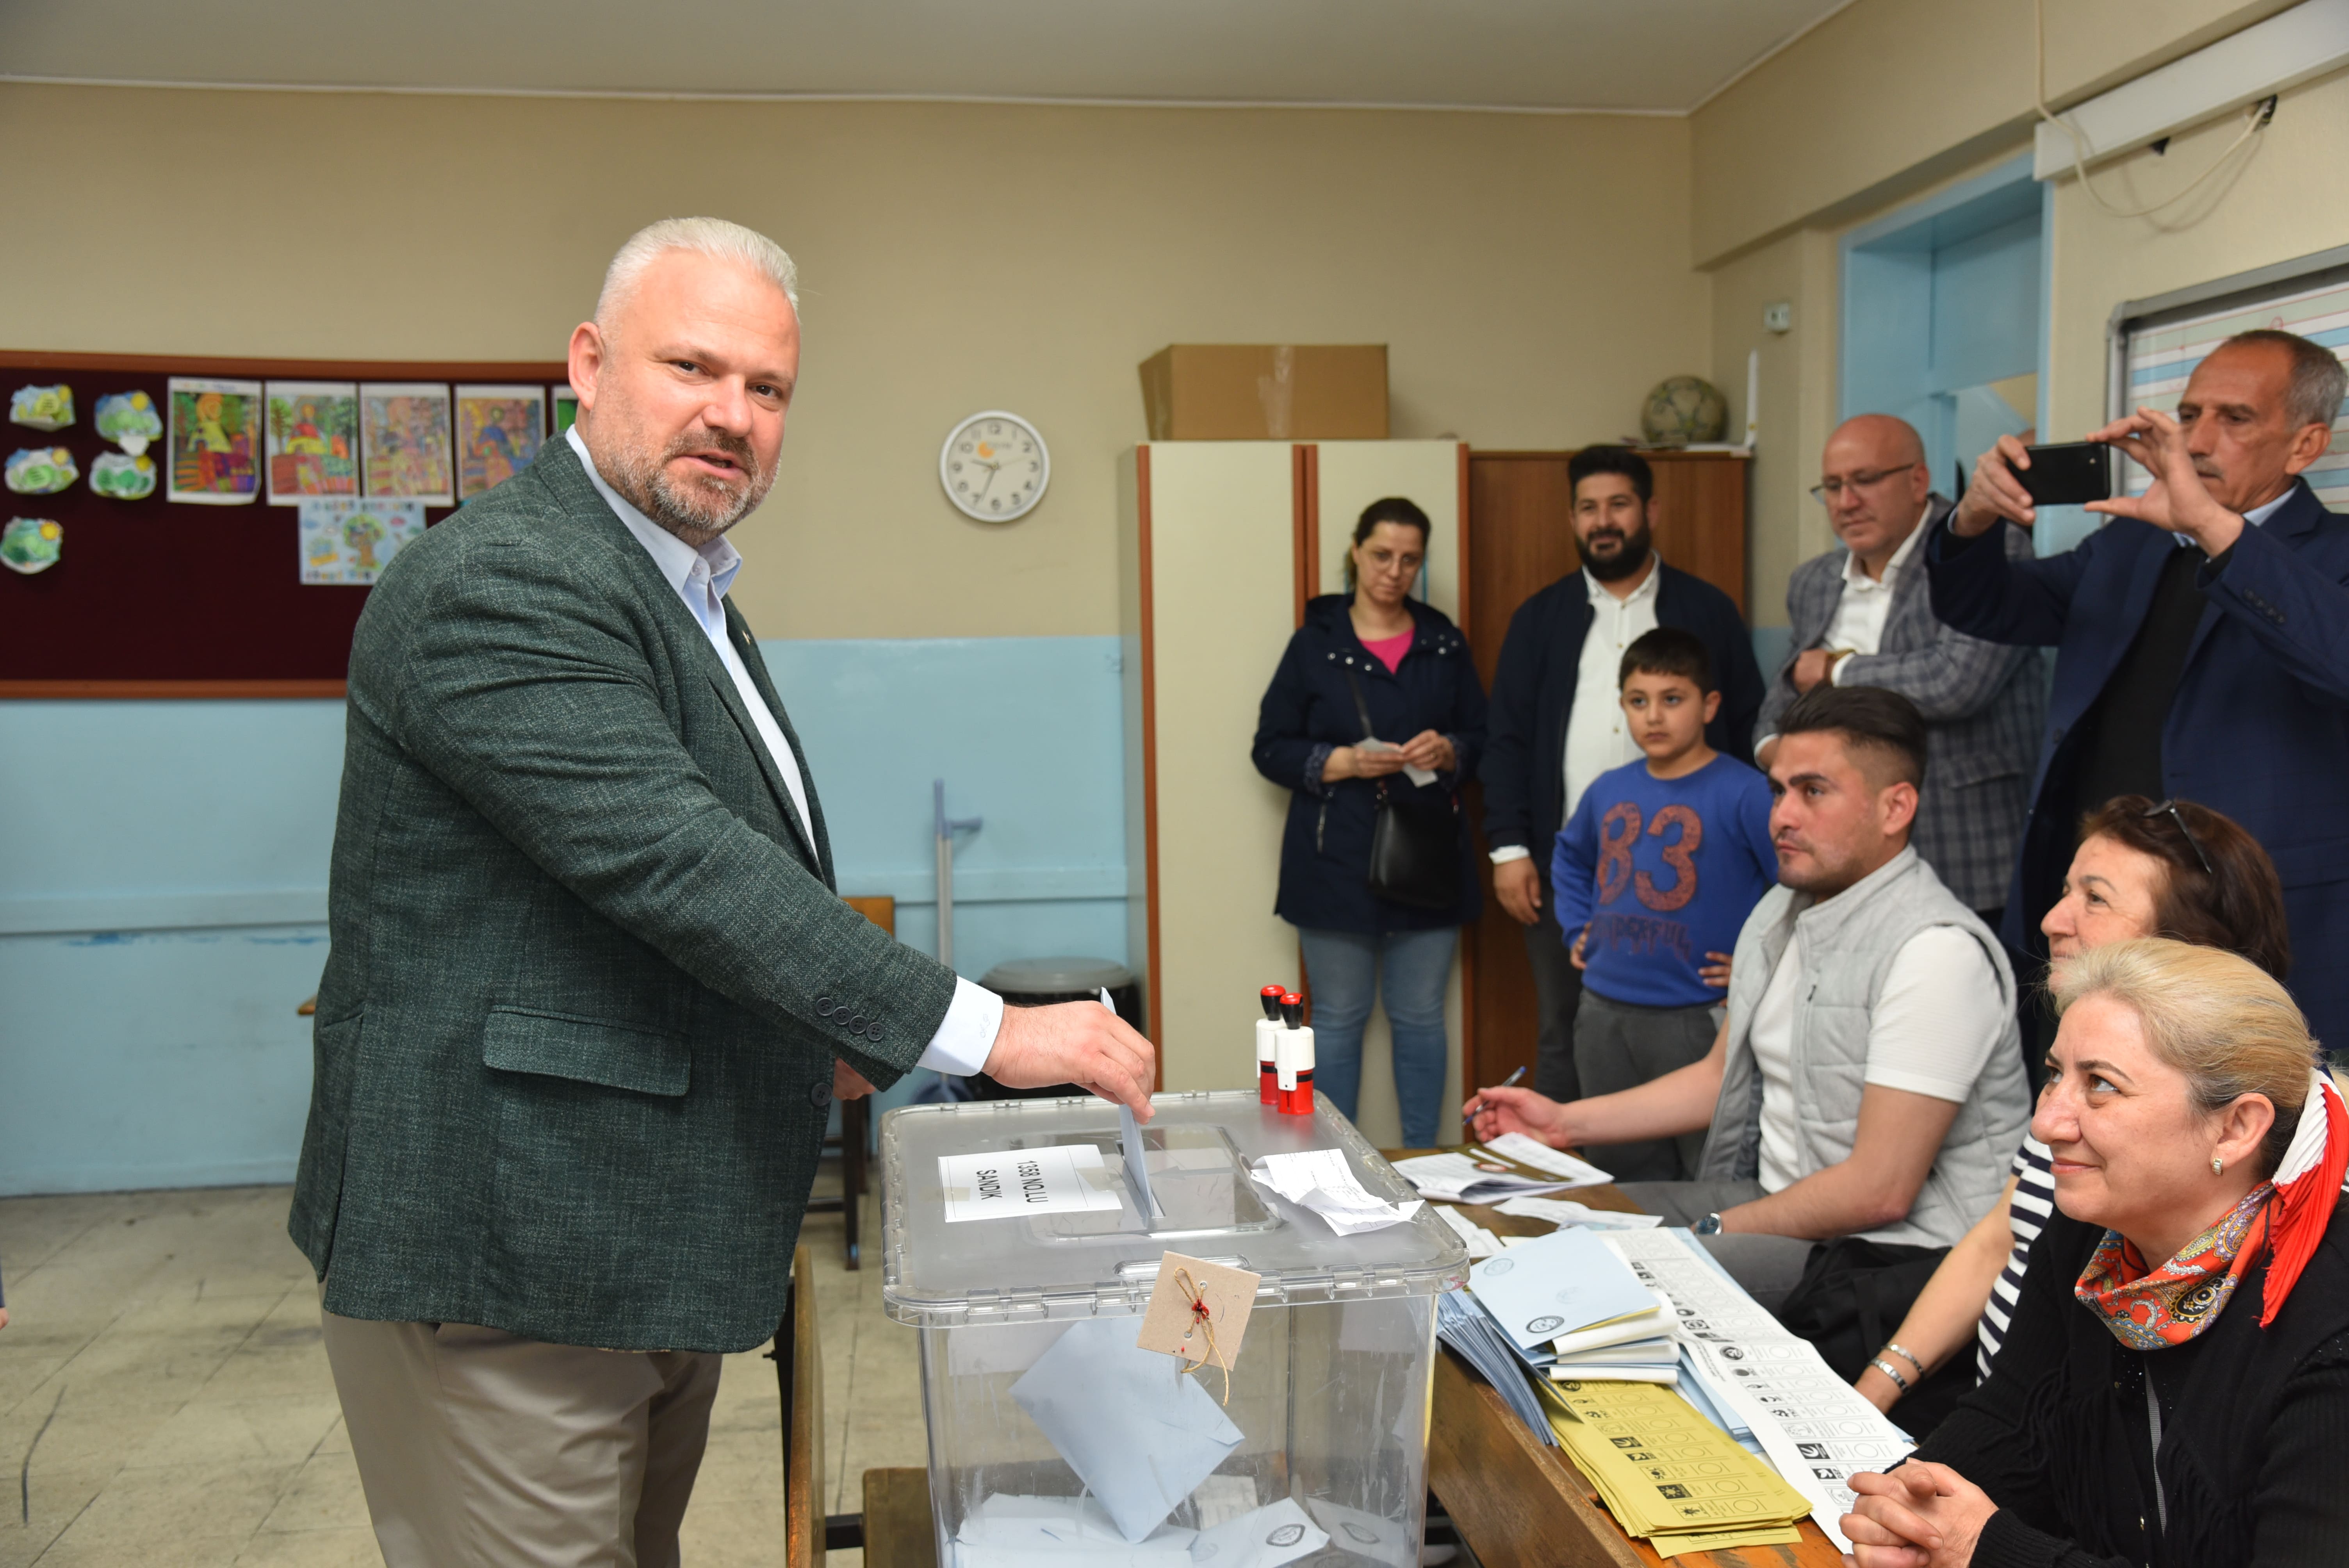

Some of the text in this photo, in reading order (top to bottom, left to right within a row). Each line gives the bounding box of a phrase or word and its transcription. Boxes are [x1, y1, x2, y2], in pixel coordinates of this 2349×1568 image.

[1023, 441, 1032, 453] 2
[1029, 460, 1039, 472] 3
[1023, 480, 1032, 490] 4
[1597, 802, 1703, 912] 83
[976, 1169, 1003, 1200] SANDIK
[1017, 1160, 1049, 1203] 1358 NO.LU
